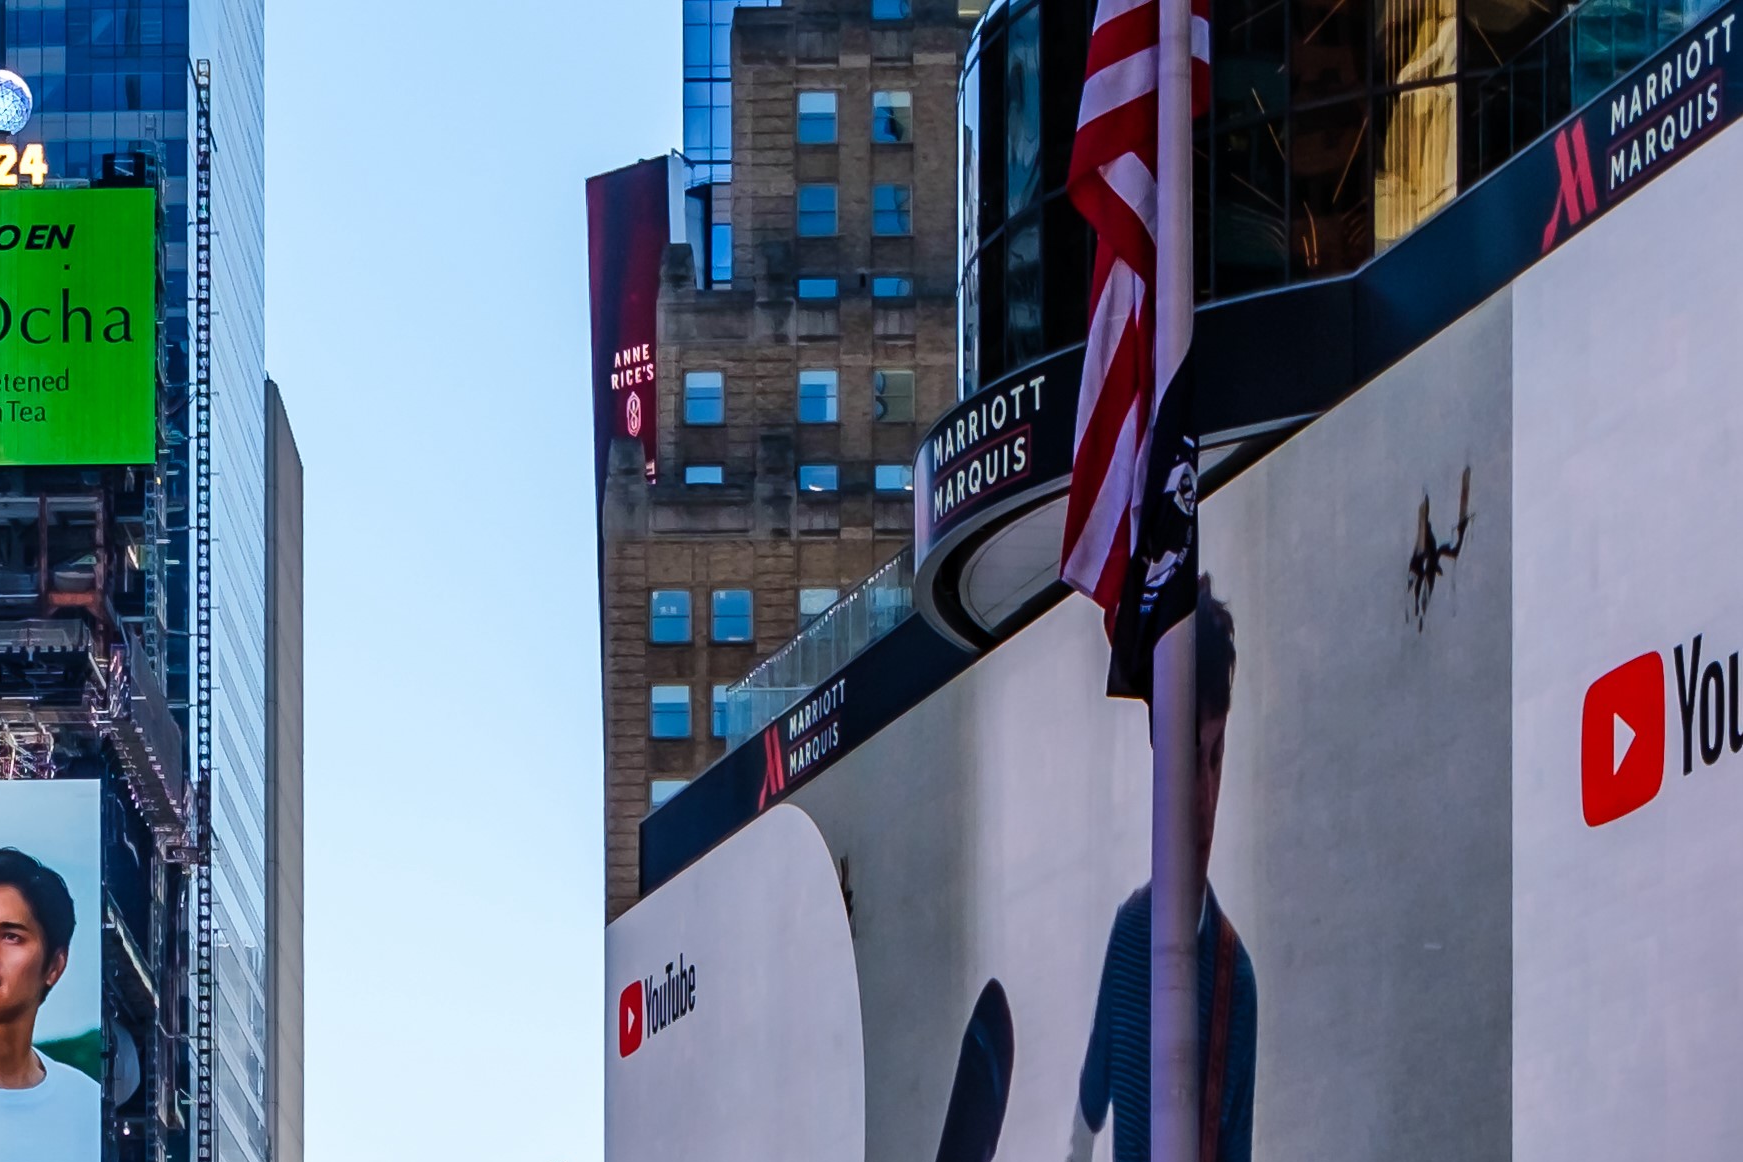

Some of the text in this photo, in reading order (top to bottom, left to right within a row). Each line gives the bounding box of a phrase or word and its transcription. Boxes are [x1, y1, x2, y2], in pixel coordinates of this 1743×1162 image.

[1611, 14, 1735, 136] MARRIOTT
[1610, 82, 1718, 190] MARQUIS
[25, 224, 75, 250] EN
[611, 363, 654, 390] RICE'S
[614, 343, 650, 368] ANNE
[6, 400, 47, 423] Tea
[932, 375, 1045, 473] MARRIOTT
[932, 436, 1028, 523] MARQUIS
[789, 677, 846, 740] MARRIOTT
[789, 721, 840, 777] MARQUIS
[644, 953, 696, 1039] YouTube
